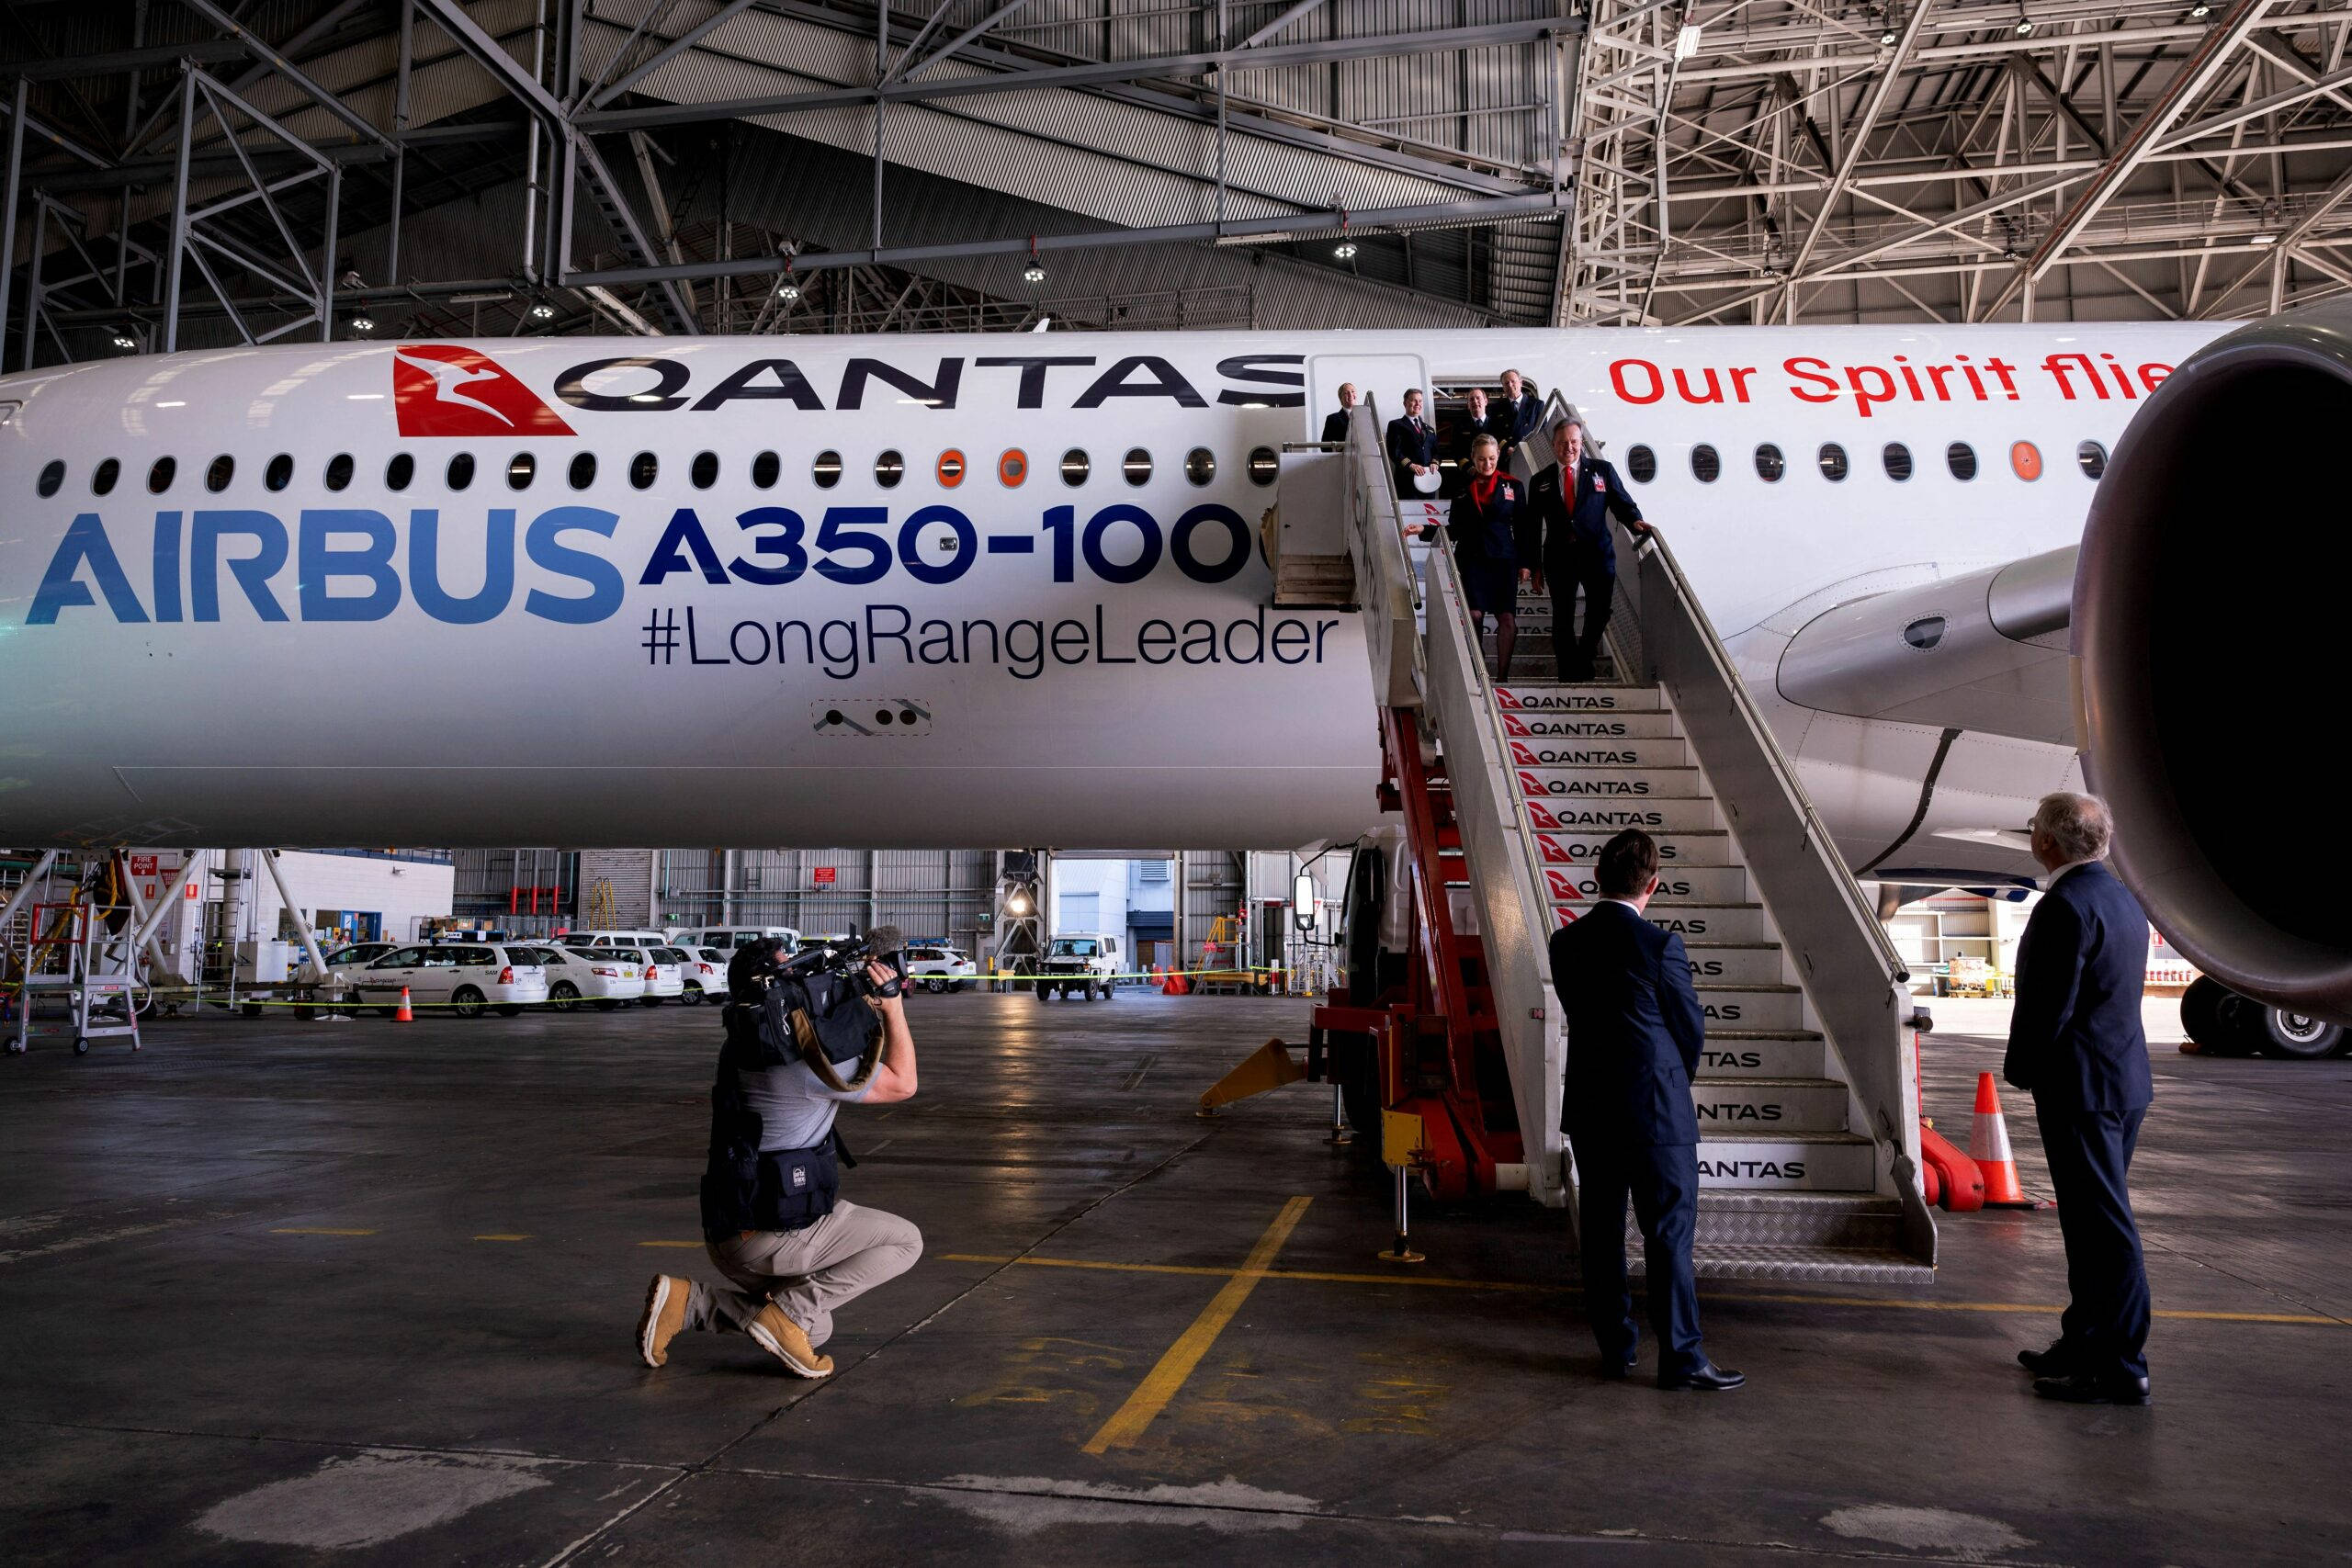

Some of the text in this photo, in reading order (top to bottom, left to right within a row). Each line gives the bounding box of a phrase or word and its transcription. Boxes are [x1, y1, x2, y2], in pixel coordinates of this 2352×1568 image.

[553, 355, 1305, 411] QANTAS
[1609, 353, 2176, 418] Our Spirit flie
[25, 506, 626, 625] AIRBUS
[639, 504, 1272, 586] A350-100
[641, 604, 1339, 680] #LongRangeLeader
[1521, 695, 1615, 708] QANTAS
[1530, 722, 1626, 736] QANTAS
[1538, 750, 1637, 764] QANTAS
[1547, 780, 1650, 795] QANTAS
[1557, 811, 1663, 825] QANTAS
[1567, 843, 1677, 859] QAS
[1578, 880, 1690, 896] QAS
[1697, 1103, 1782, 1120] NTAS
[1698, 1160, 1805, 1179] ANTAS
